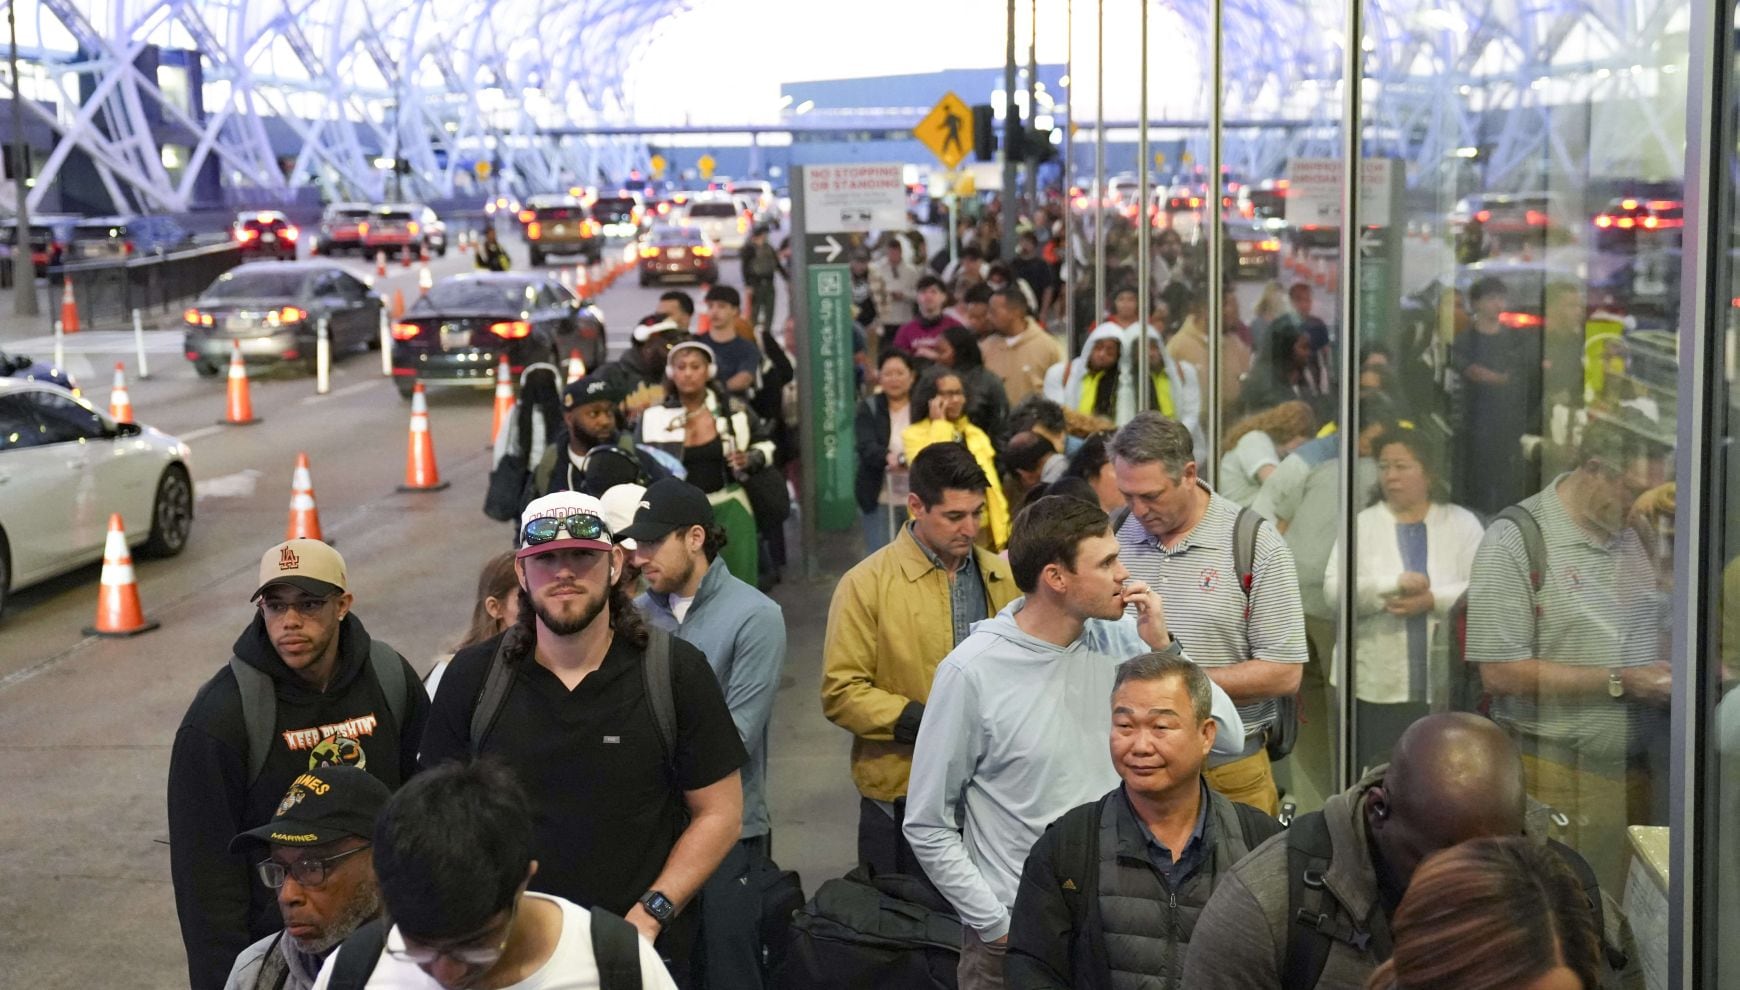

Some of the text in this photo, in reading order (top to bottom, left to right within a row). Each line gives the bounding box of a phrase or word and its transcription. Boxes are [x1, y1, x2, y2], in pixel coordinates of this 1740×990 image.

[810, 166, 898, 179] NO STOPPING
[810, 180, 899, 191] OR STANDING
[820, 297, 833, 355] Pick-Up
[822, 358, 836, 431] Rideshare
[824, 434, 836, 459] NO
[279, 546, 299, 570] LA
[271, 832, 318, 842] MARINES
